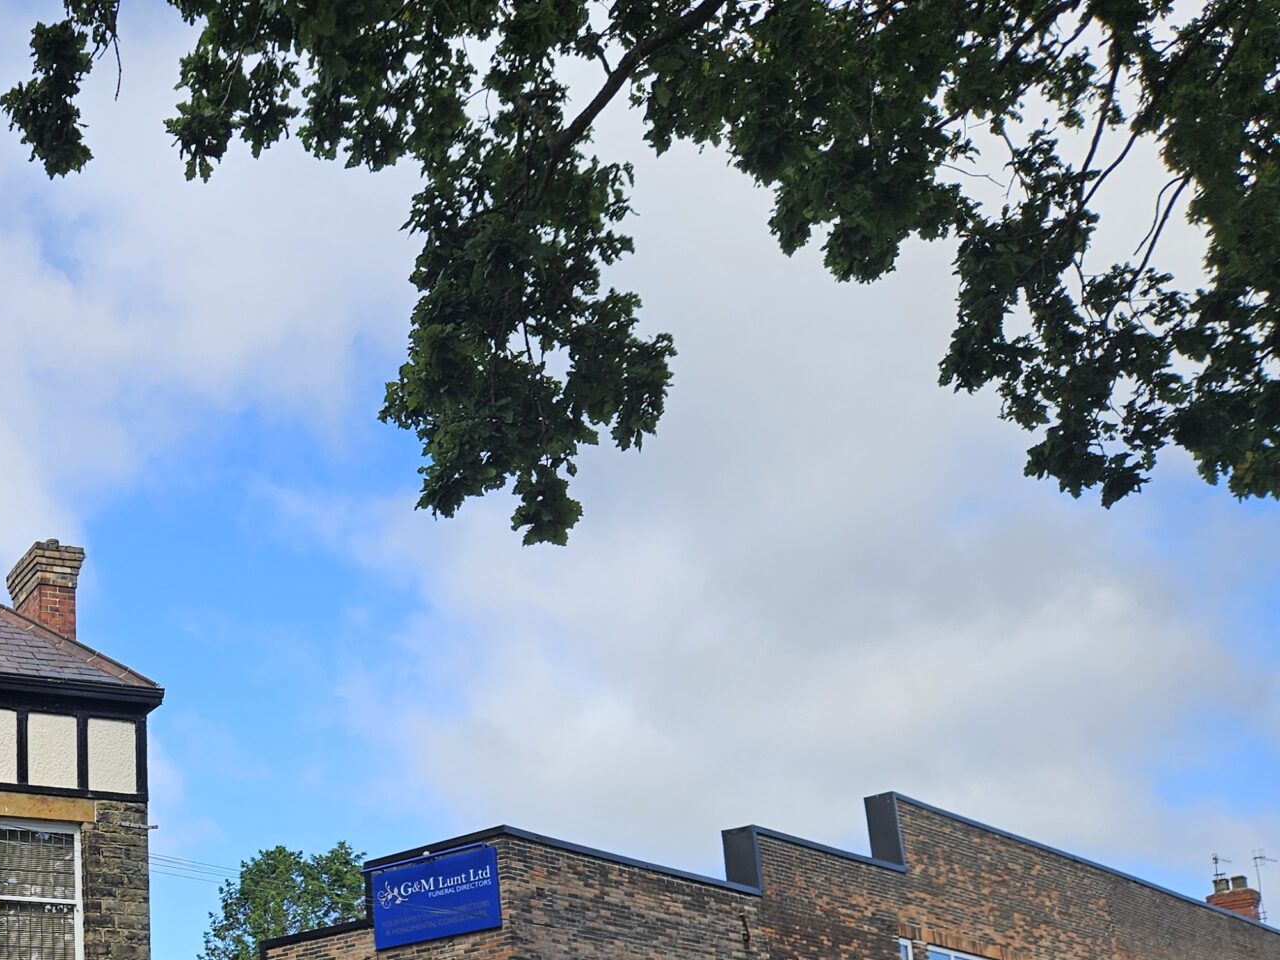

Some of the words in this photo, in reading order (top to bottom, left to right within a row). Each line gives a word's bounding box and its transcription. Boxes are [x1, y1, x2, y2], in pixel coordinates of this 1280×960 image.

[400, 877, 434, 896] G&M
[438, 875, 466, 888] Lunt
[469, 865, 490, 881] Ltd
[428, 887, 456, 898] FUNERAL
[456, 880, 492, 891] DIRECTORS
